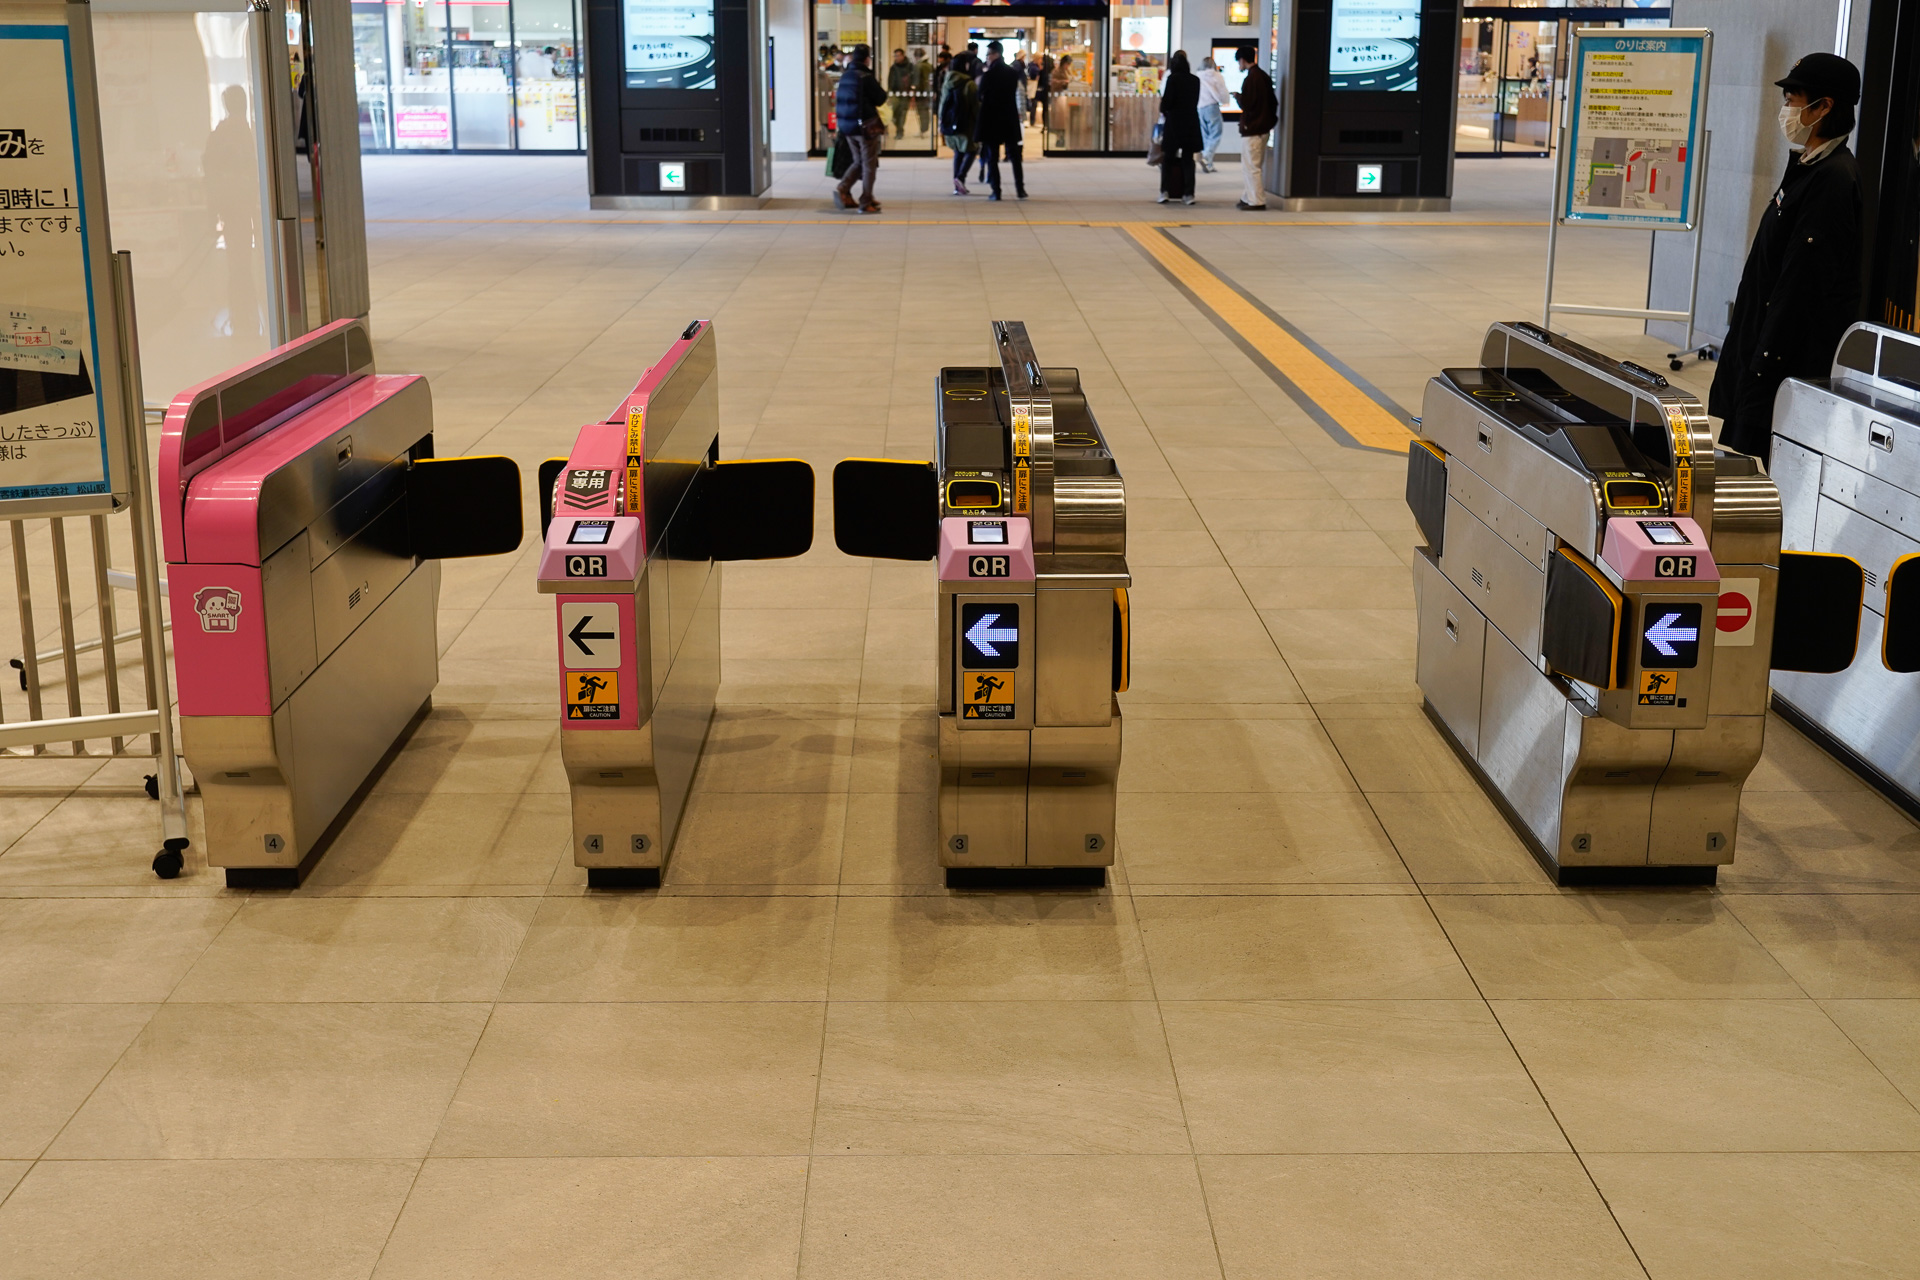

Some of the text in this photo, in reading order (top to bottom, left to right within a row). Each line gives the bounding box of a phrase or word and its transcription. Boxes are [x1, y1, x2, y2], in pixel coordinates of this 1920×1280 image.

[1615, 40, 1667, 51] のりば案内
[24, 335, 43, 345] 見本
[630, 414, 640, 454] かけこみ禁止
[1017, 415, 1028, 455] かけこみ禁止
[77, 483, 106, 494] 松山駅
[571, 477, 605, 489] 専用
[629, 469, 639, 511] 扉にご注意
[1018, 470, 1027, 511] 扉にご注意
[1678, 470, 1689, 511] 扉にご注意
[569, 557, 604, 576] QR
[972, 557, 1006, 576] QR
[1658, 557, 1692, 576] QR
[583, 705, 617, 713] 扉にご注意
[979, 705, 1013, 713] 扉にご注意
[269, 838, 278, 849] 4
[590, 838, 599, 849] 4
[635, 838, 644, 849] 3
[955, 838, 965, 850] 3
[1089, 838, 1098, 849] 2
[1578, 838, 1588, 849] 2
[1711, 836, 1718, 848] 1
